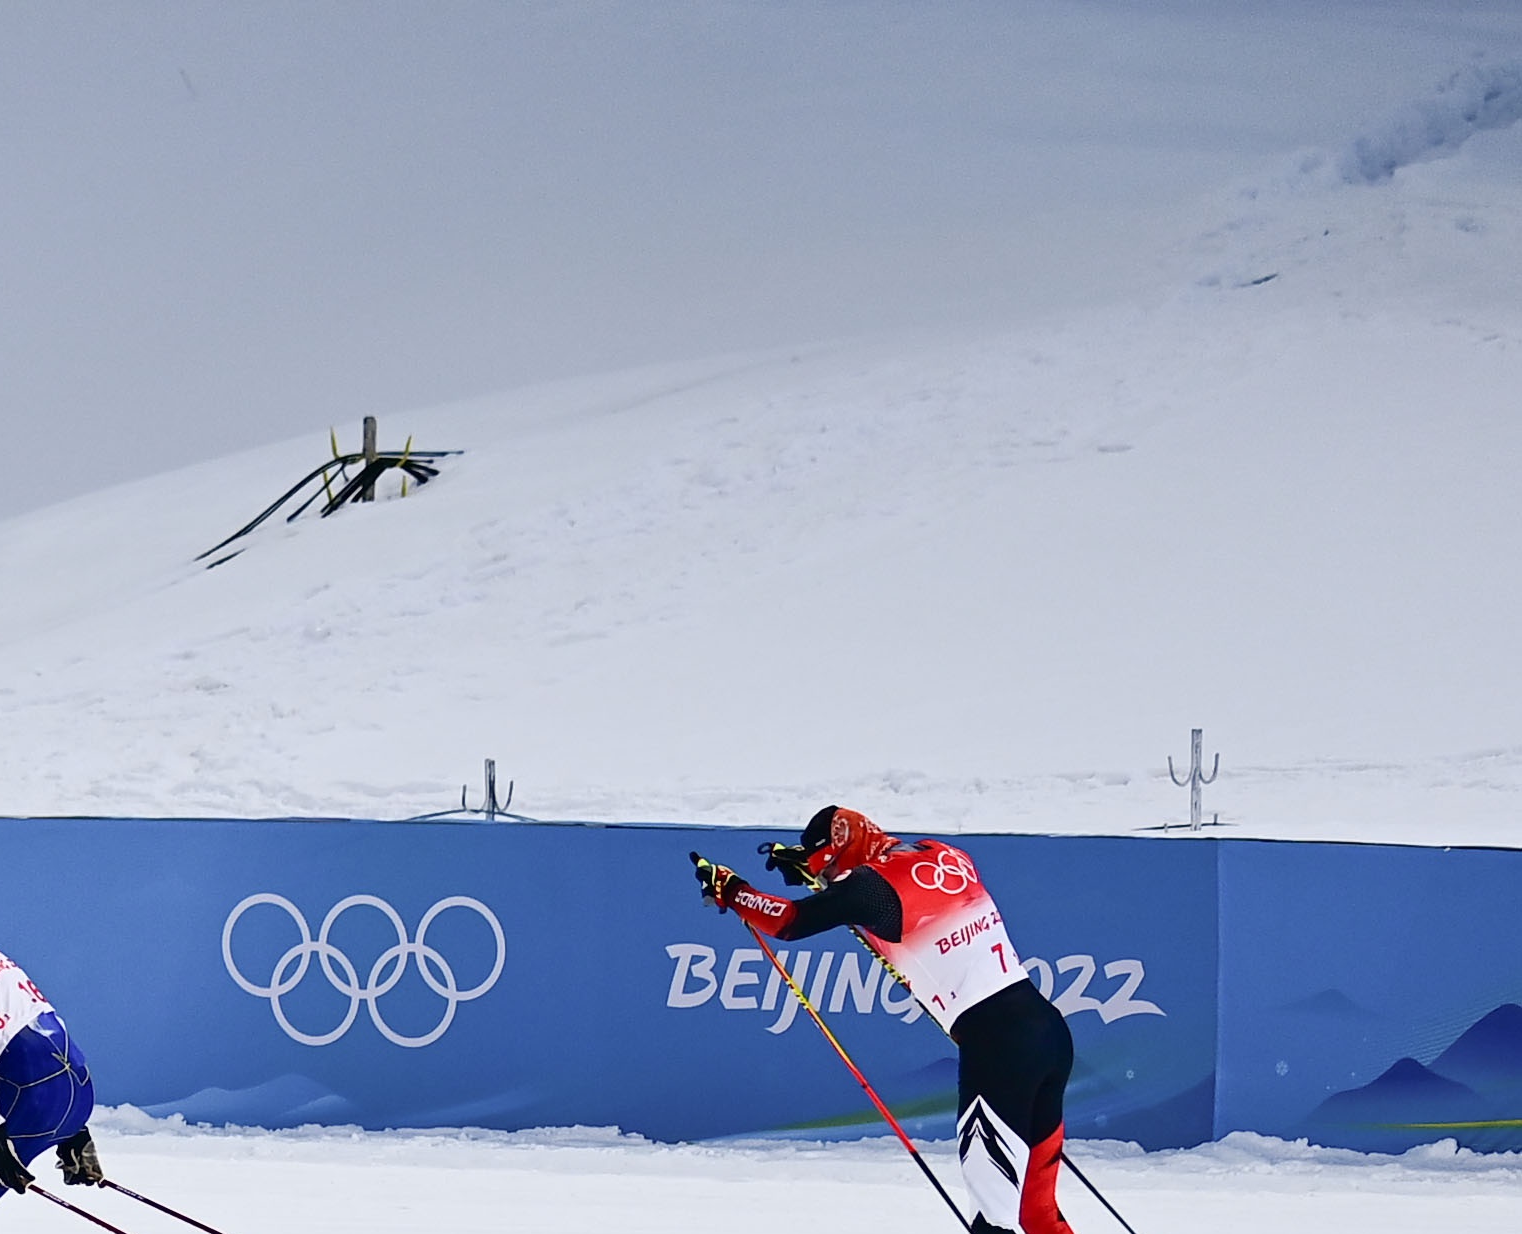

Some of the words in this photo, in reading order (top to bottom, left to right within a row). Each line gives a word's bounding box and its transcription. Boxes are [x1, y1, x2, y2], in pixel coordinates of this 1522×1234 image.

[934, 915, 990, 955] BEIJING
[990, 942, 1007, 974] 7
[1025, 954, 1168, 1025] 022
